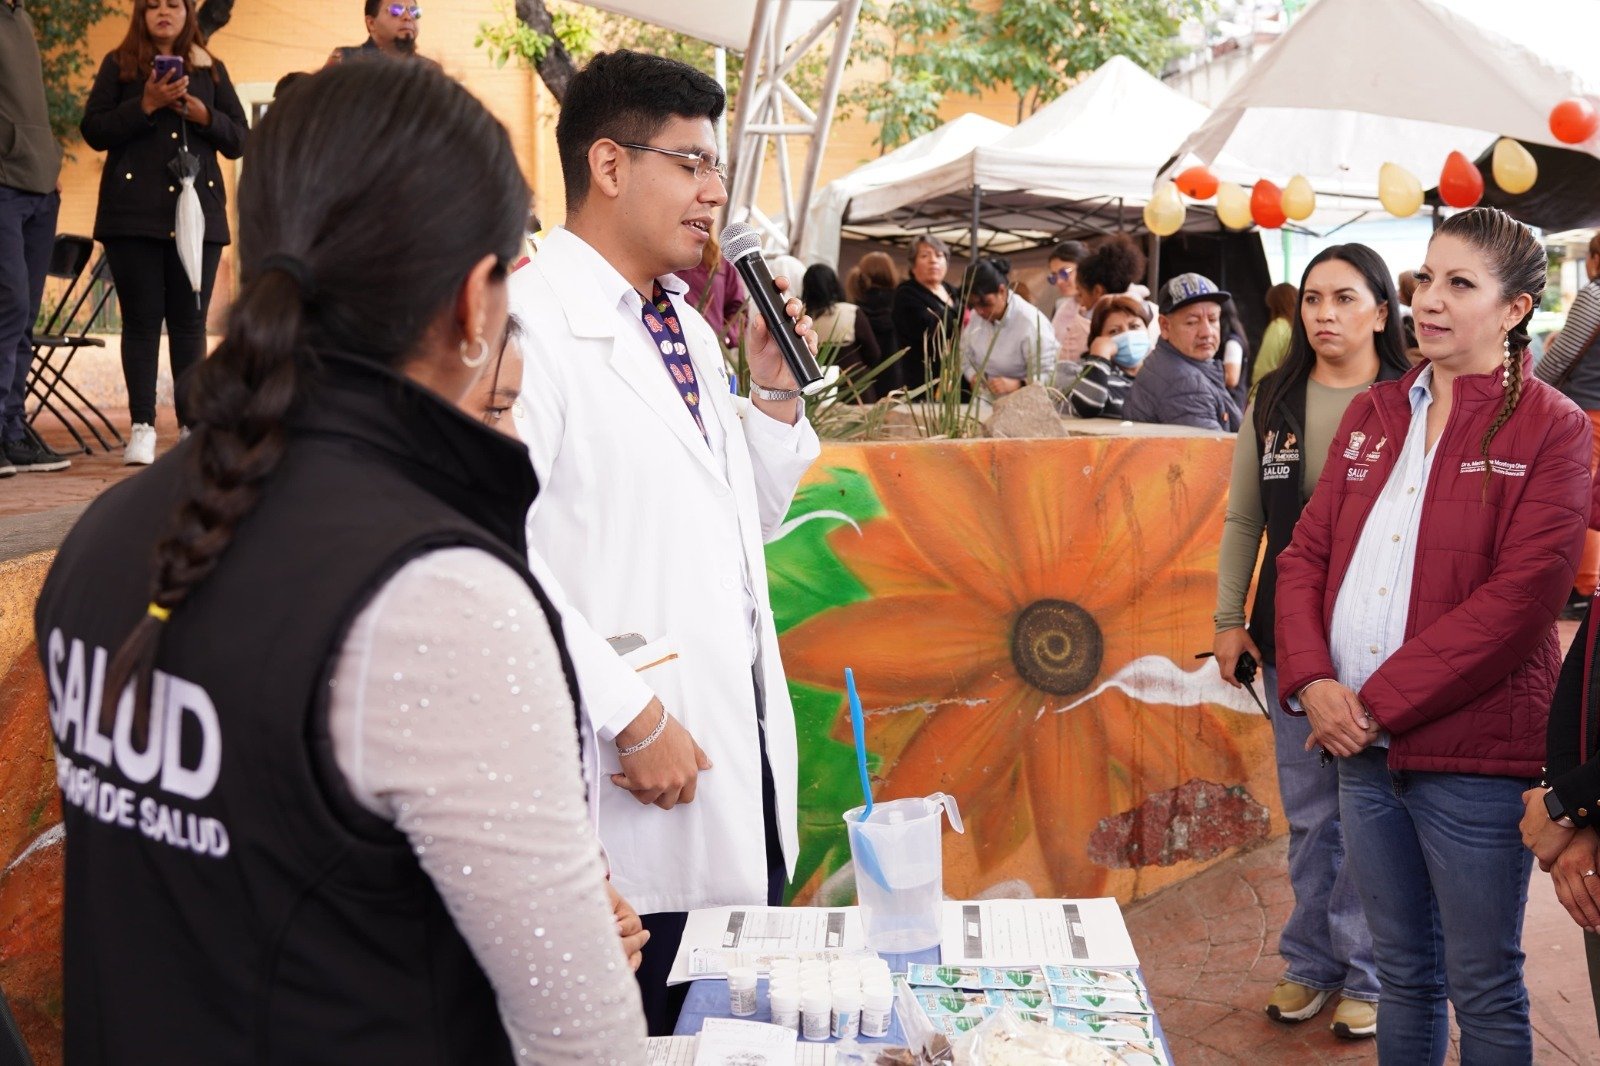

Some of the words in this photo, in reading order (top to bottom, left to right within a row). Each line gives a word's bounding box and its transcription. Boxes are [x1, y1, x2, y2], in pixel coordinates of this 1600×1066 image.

[1263, 466, 1290, 476] SALUD
[48, 626, 222, 801] SALUD
[98, 781, 137, 828] DE
[139, 796, 230, 858] SALUD
